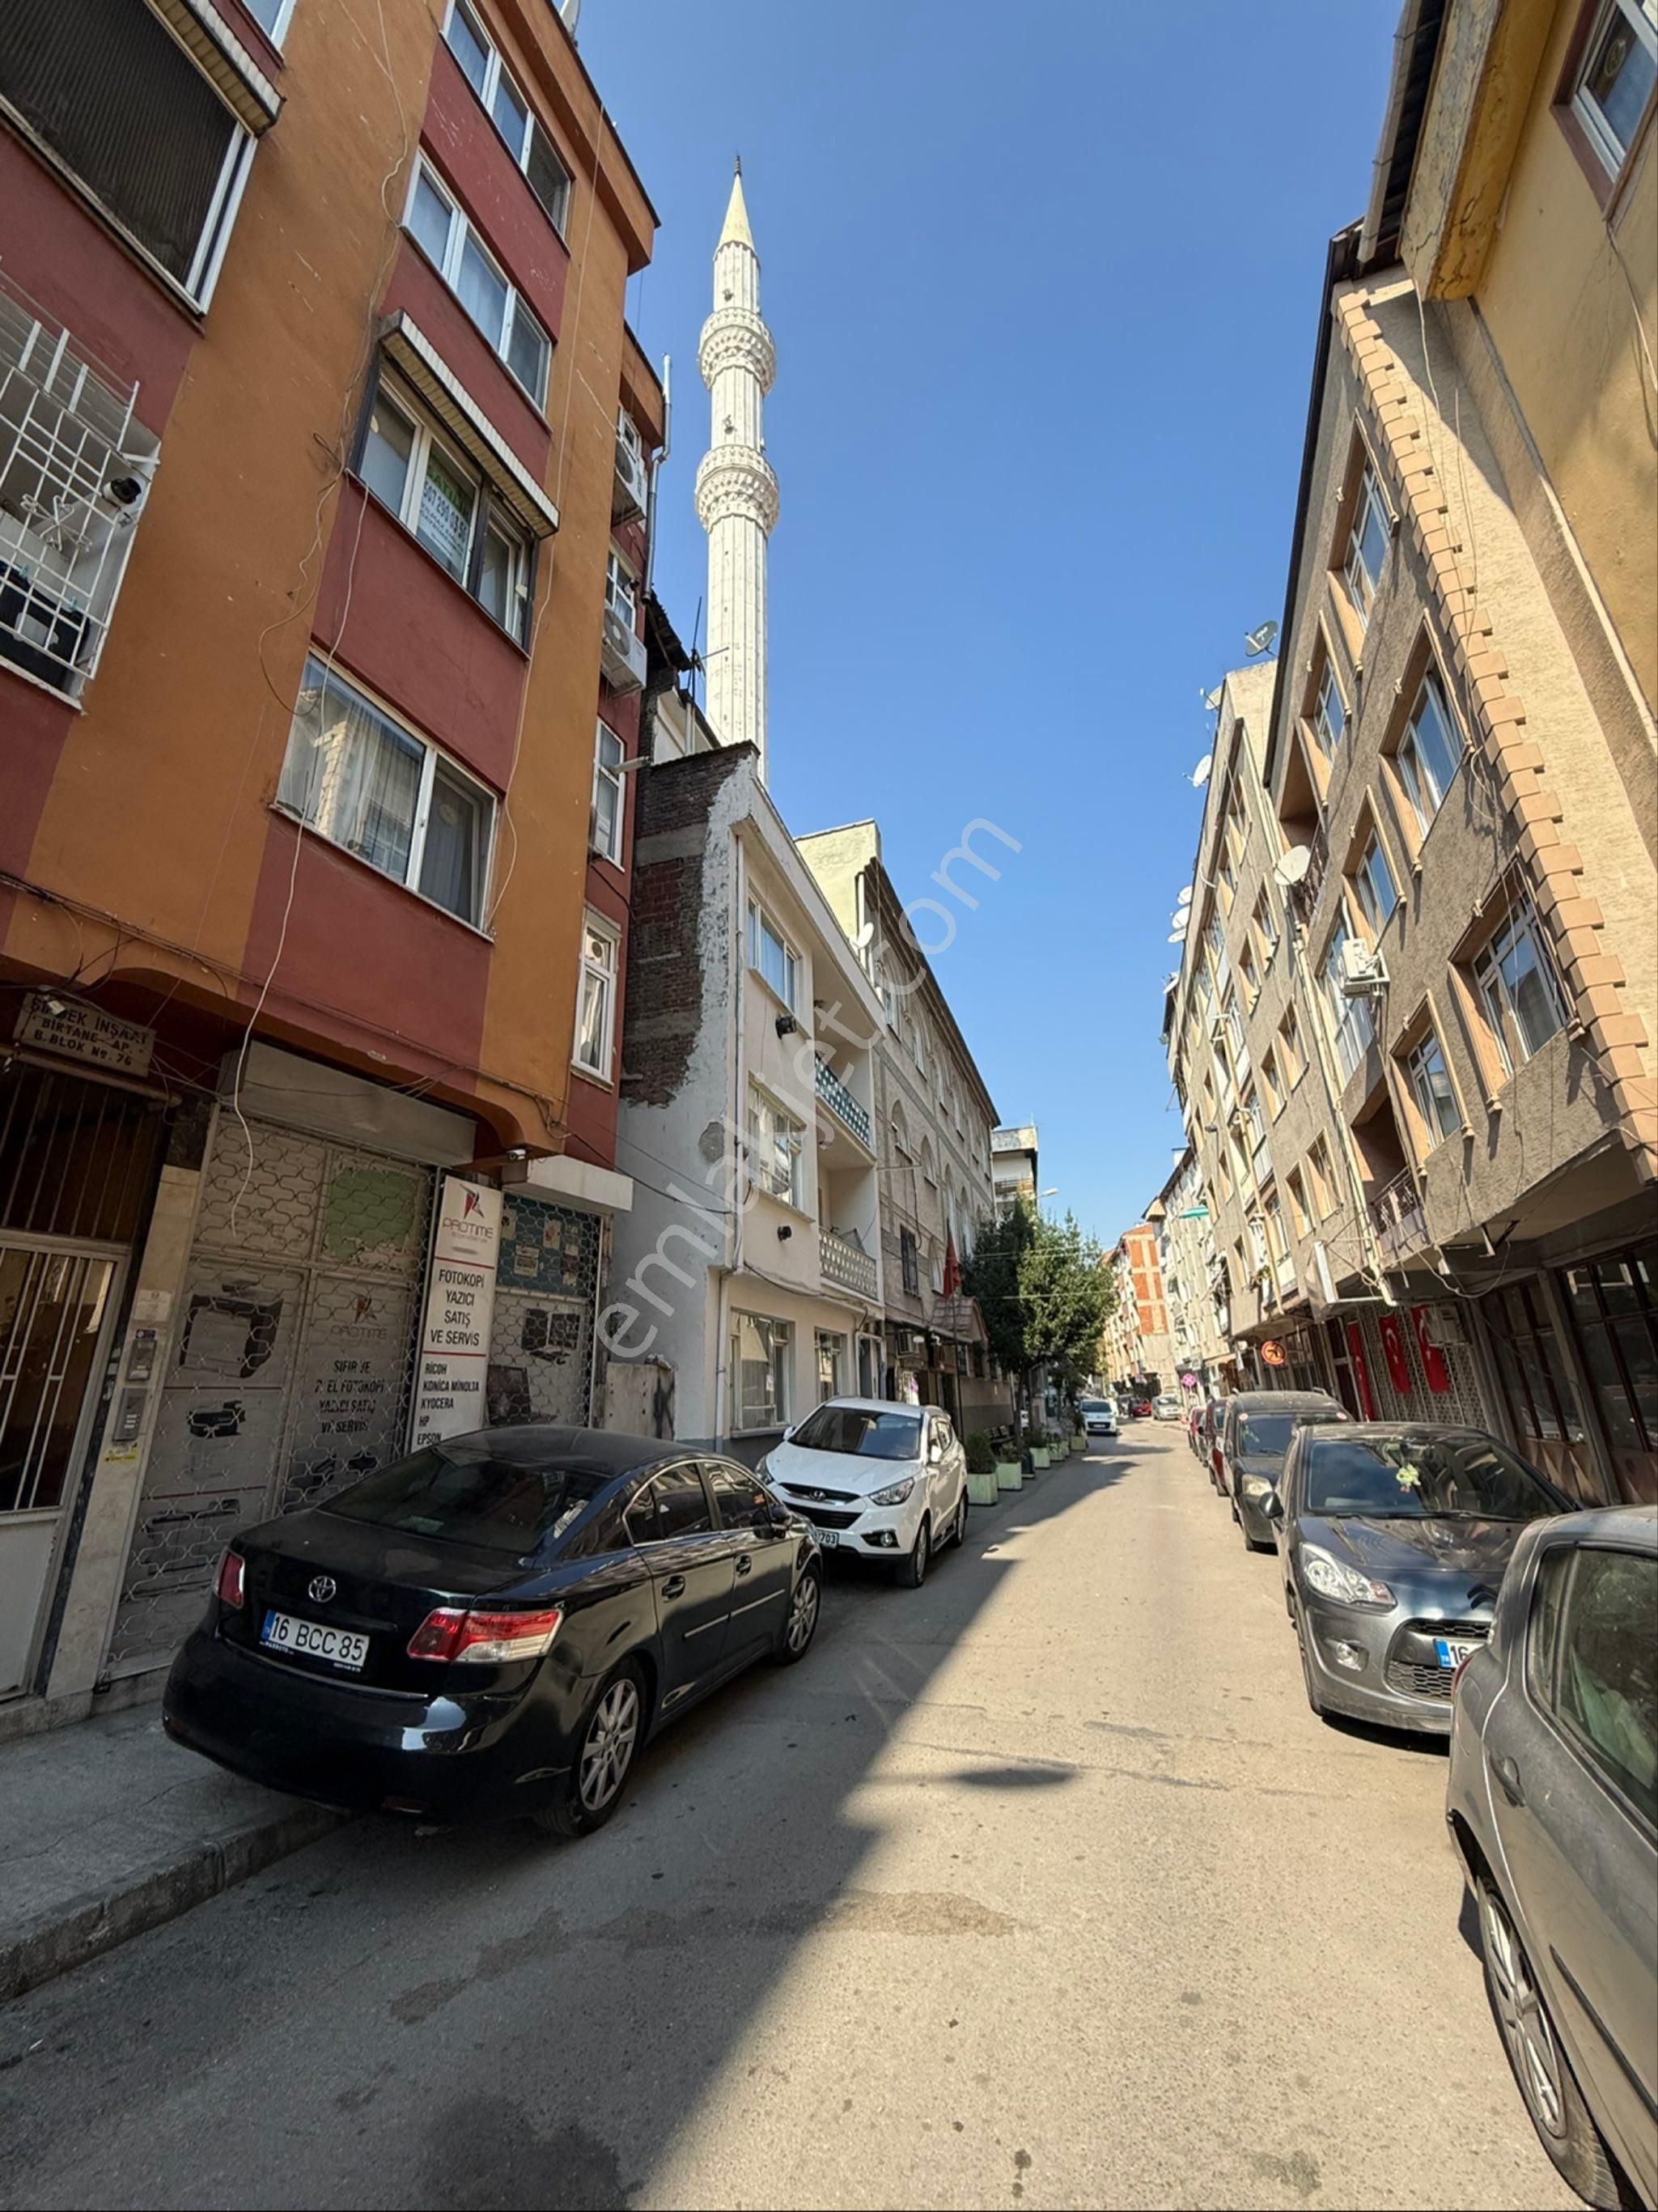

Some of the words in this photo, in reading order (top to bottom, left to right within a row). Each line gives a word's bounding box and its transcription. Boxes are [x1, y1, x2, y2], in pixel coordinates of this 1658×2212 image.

[42, 1018, 99, 1043] BİRTANE
[439, 1269, 485, 1288] FOTOKOPİ
[446, 1289, 475, 1306] YAZICI
[444, 1310, 471, 1328] SATIŞ
[430, 1329, 443, 1344] VE
[445, 1330, 480, 1346] SERVİS
[422, 1397, 453, 1409] KYOCERA
[418, 1415, 430, 1427] HP
[417, 1433, 441, 1446] EPSON
[272, 1616, 290, 1641] 16
[295, 1623, 337, 1654] BCC
[338, 1636, 364, 1661] 85
